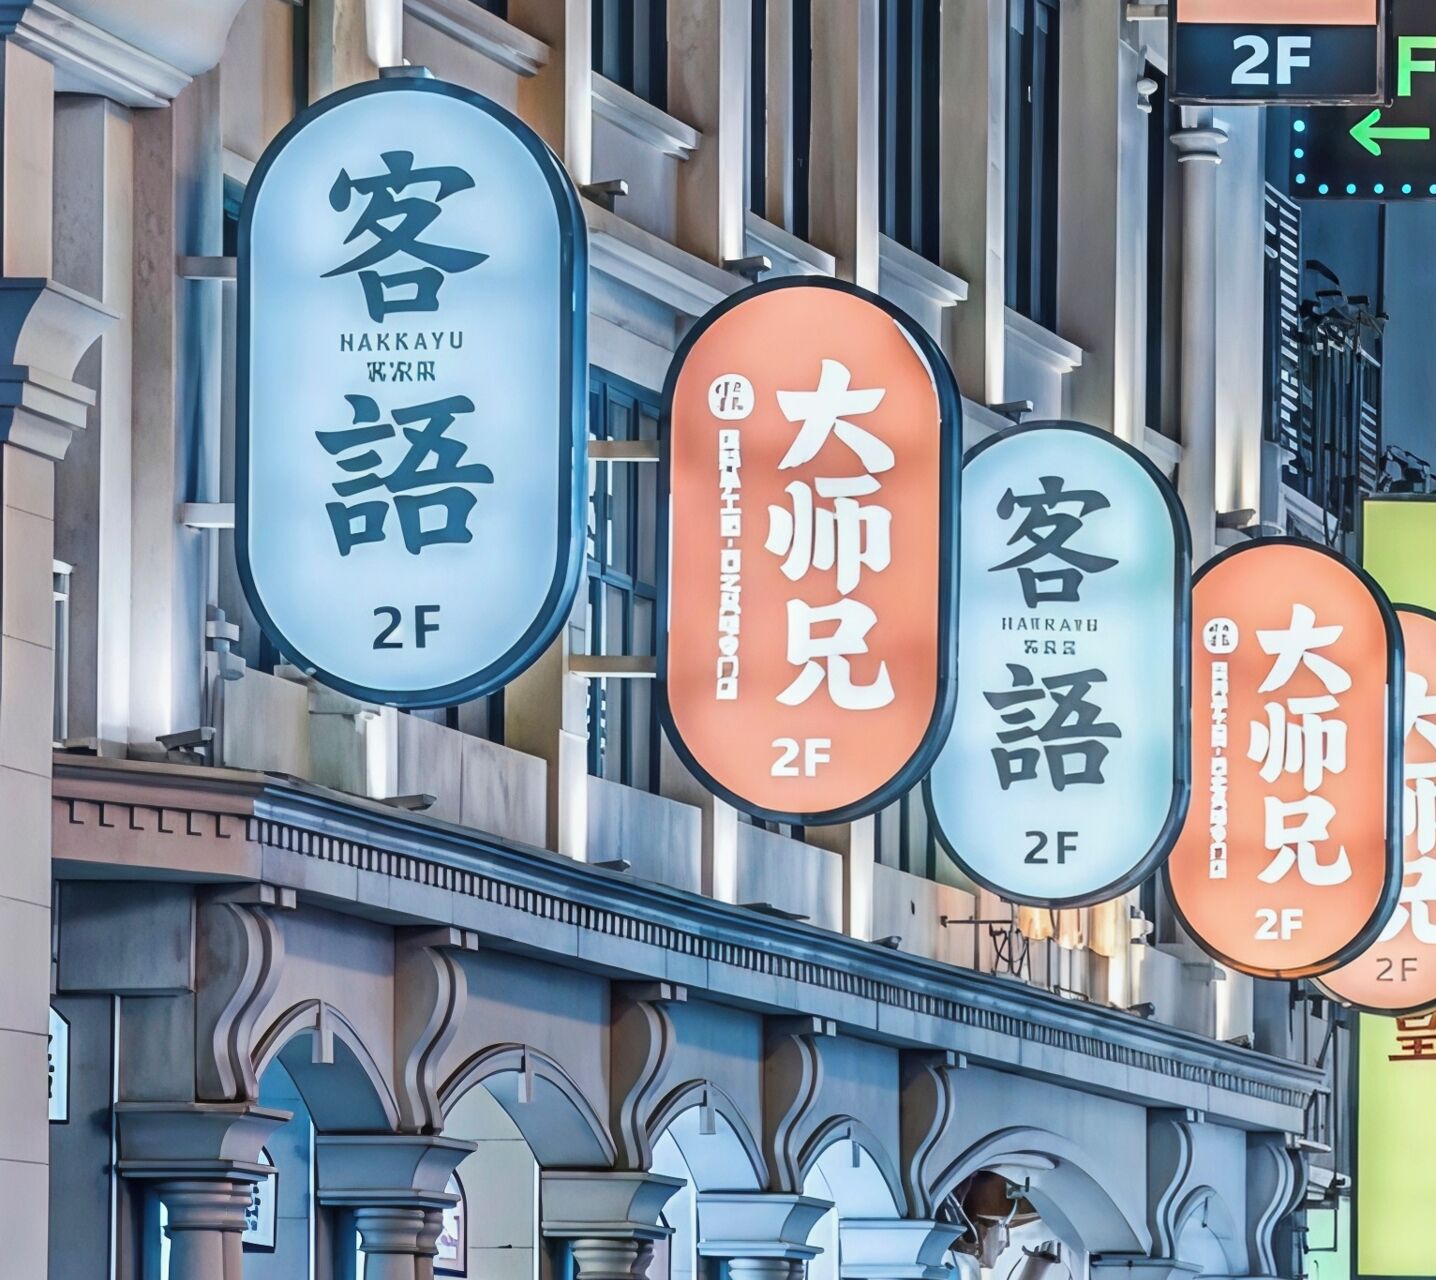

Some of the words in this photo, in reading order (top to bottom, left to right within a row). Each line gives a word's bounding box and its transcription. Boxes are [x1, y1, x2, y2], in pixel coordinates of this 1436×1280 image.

[1230, 34, 1311, 86] 2F
[340, 331, 463, 352] HAKKAYU
[764, 359, 896, 711] 大师兄
[372, 604, 442, 650] 2F
[770, 738, 833, 778] 2F
[1246, 603, 1353, 887] 大师兄
[1023, 830, 1080, 865] 2F
[1254, 908, 1304, 941] 2F
[1376, 957, 1418, 982] 2F
